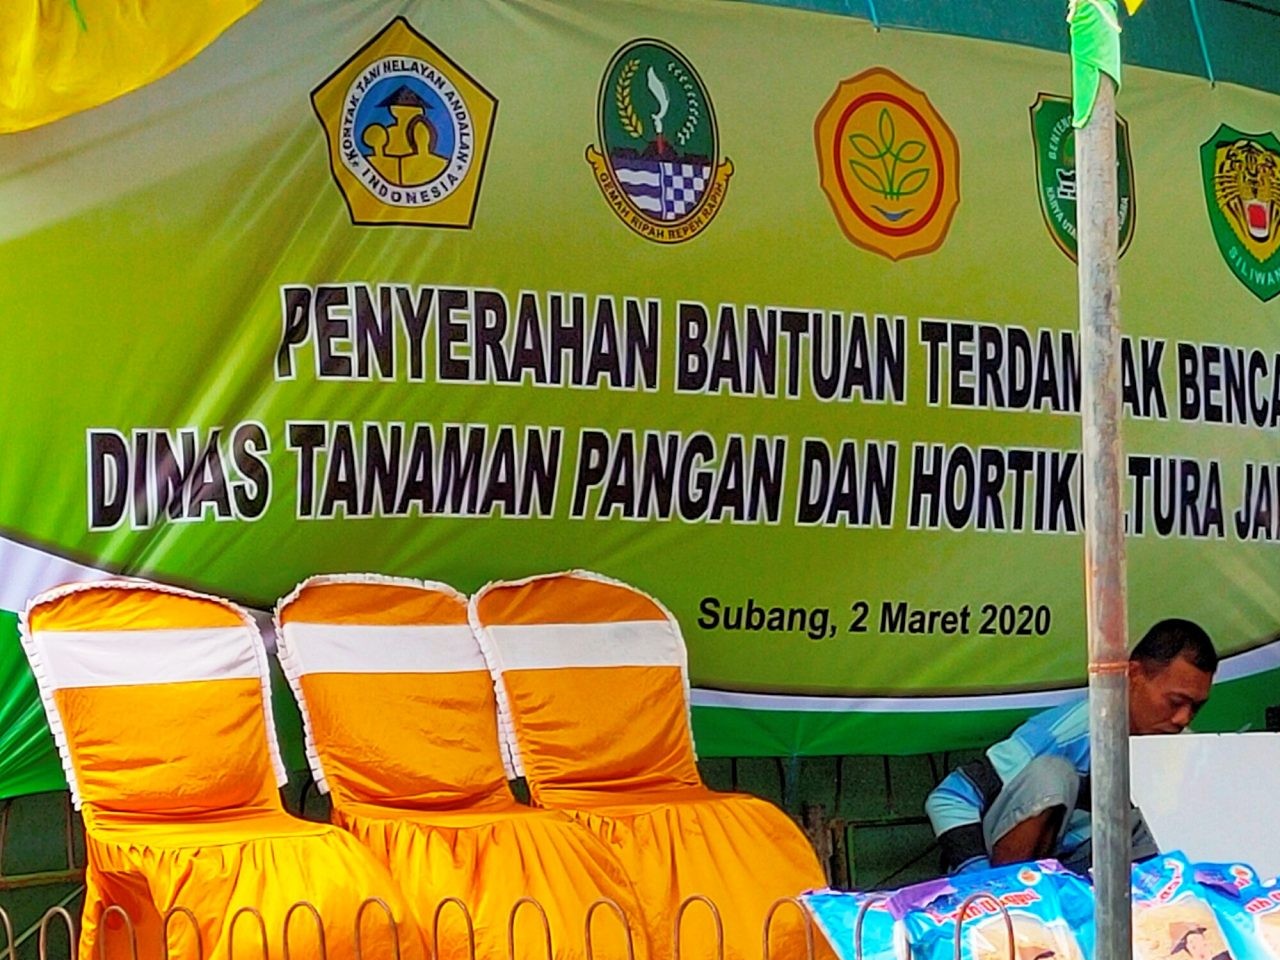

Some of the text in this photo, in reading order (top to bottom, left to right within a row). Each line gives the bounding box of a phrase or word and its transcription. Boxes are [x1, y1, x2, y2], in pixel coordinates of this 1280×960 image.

[342, 60, 471, 164] KONTAK TANI NELAYAN ANDALAN
[362, 168, 459, 204] INDONESIA
[277, 284, 661, 391] PENYERAHAN
[677, 303, 905, 402] BANTUAN
[919, 318, 1168, 419] TERDAMAK
[87, 423, 270, 530] DINAS
[287, 421, 563, 519] TANAMAN
[571, 429, 785, 524] PANGAN
[797, 440, 898, 528] DAN
[908, 446, 1225, 539] HORTIKTURA
[698, 596, 1051, 640] Subang, 2 Maret 2020
